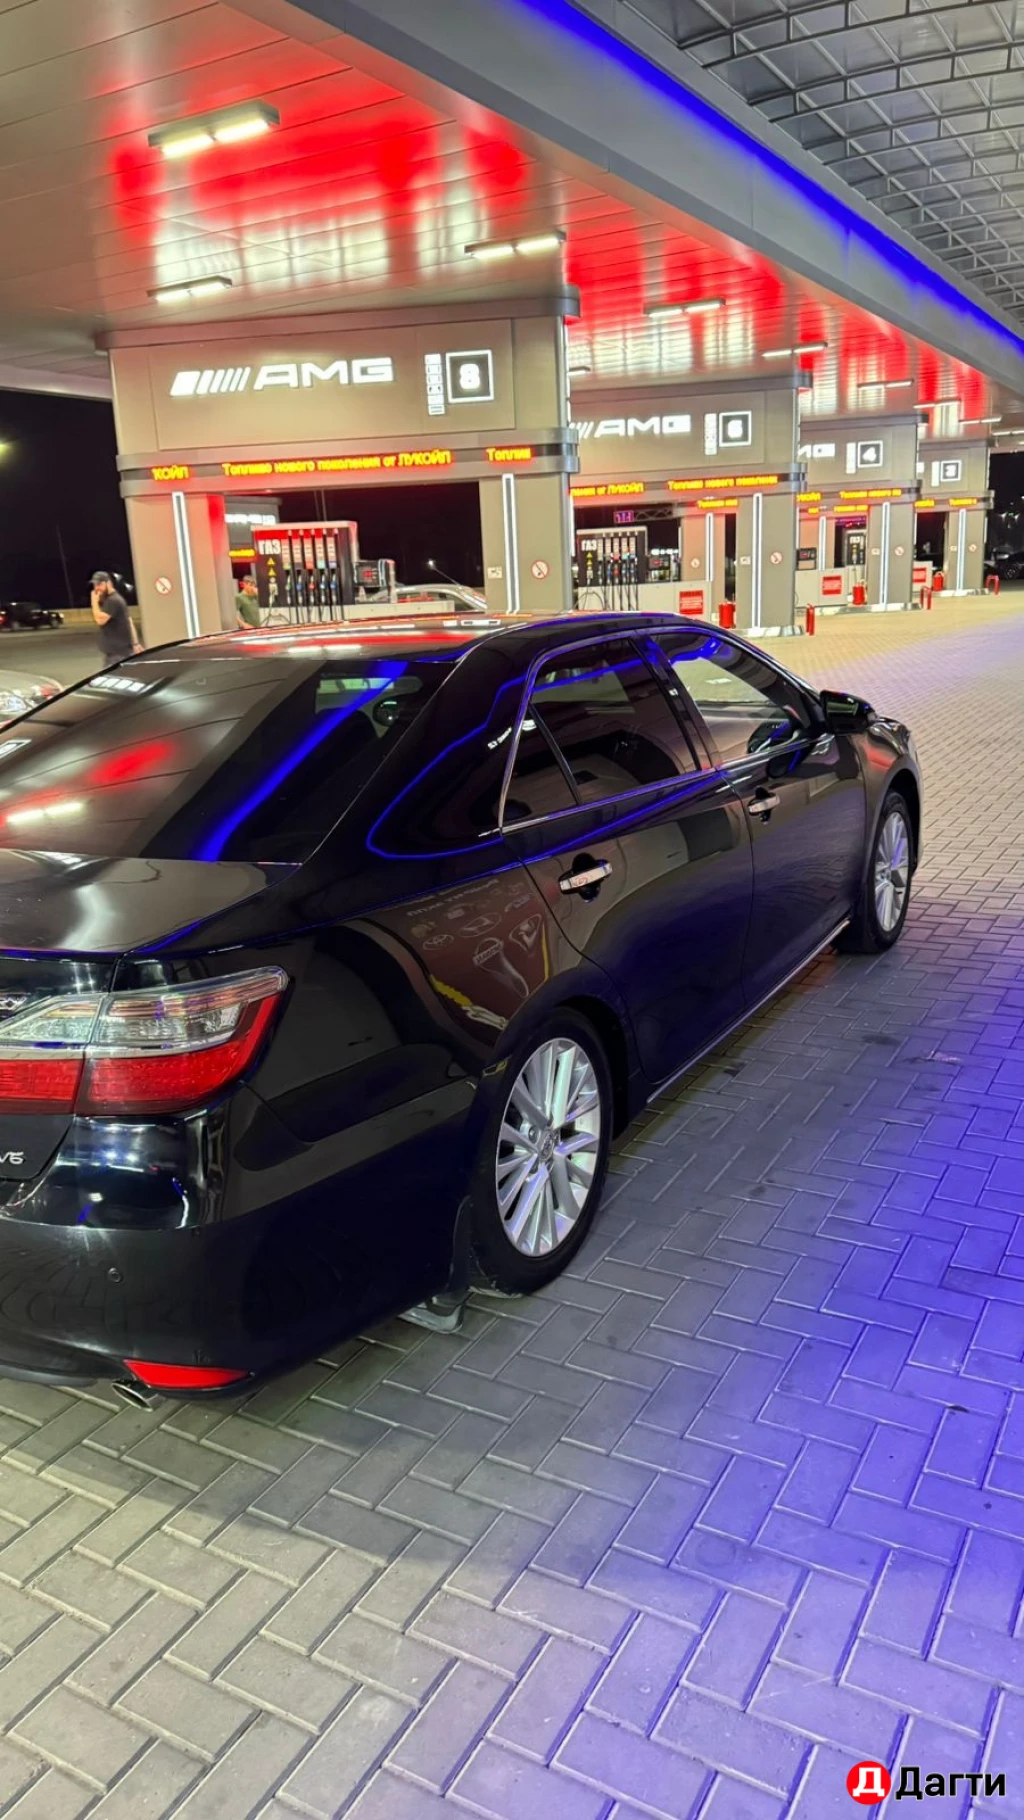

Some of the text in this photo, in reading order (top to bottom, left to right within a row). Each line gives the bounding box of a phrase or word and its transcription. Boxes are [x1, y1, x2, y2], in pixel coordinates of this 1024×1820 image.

[253, 357, 393, 390] AMG
[460, 364, 480, 389] 8
[593, 414, 691, 438] AMG
[727, 419, 743, 438] 6
[398, 448, 452, 466] ЛУКОЙЛ
[862, 447, 877, 462] 4
[258, 539, 281, 555] ГАЗ
